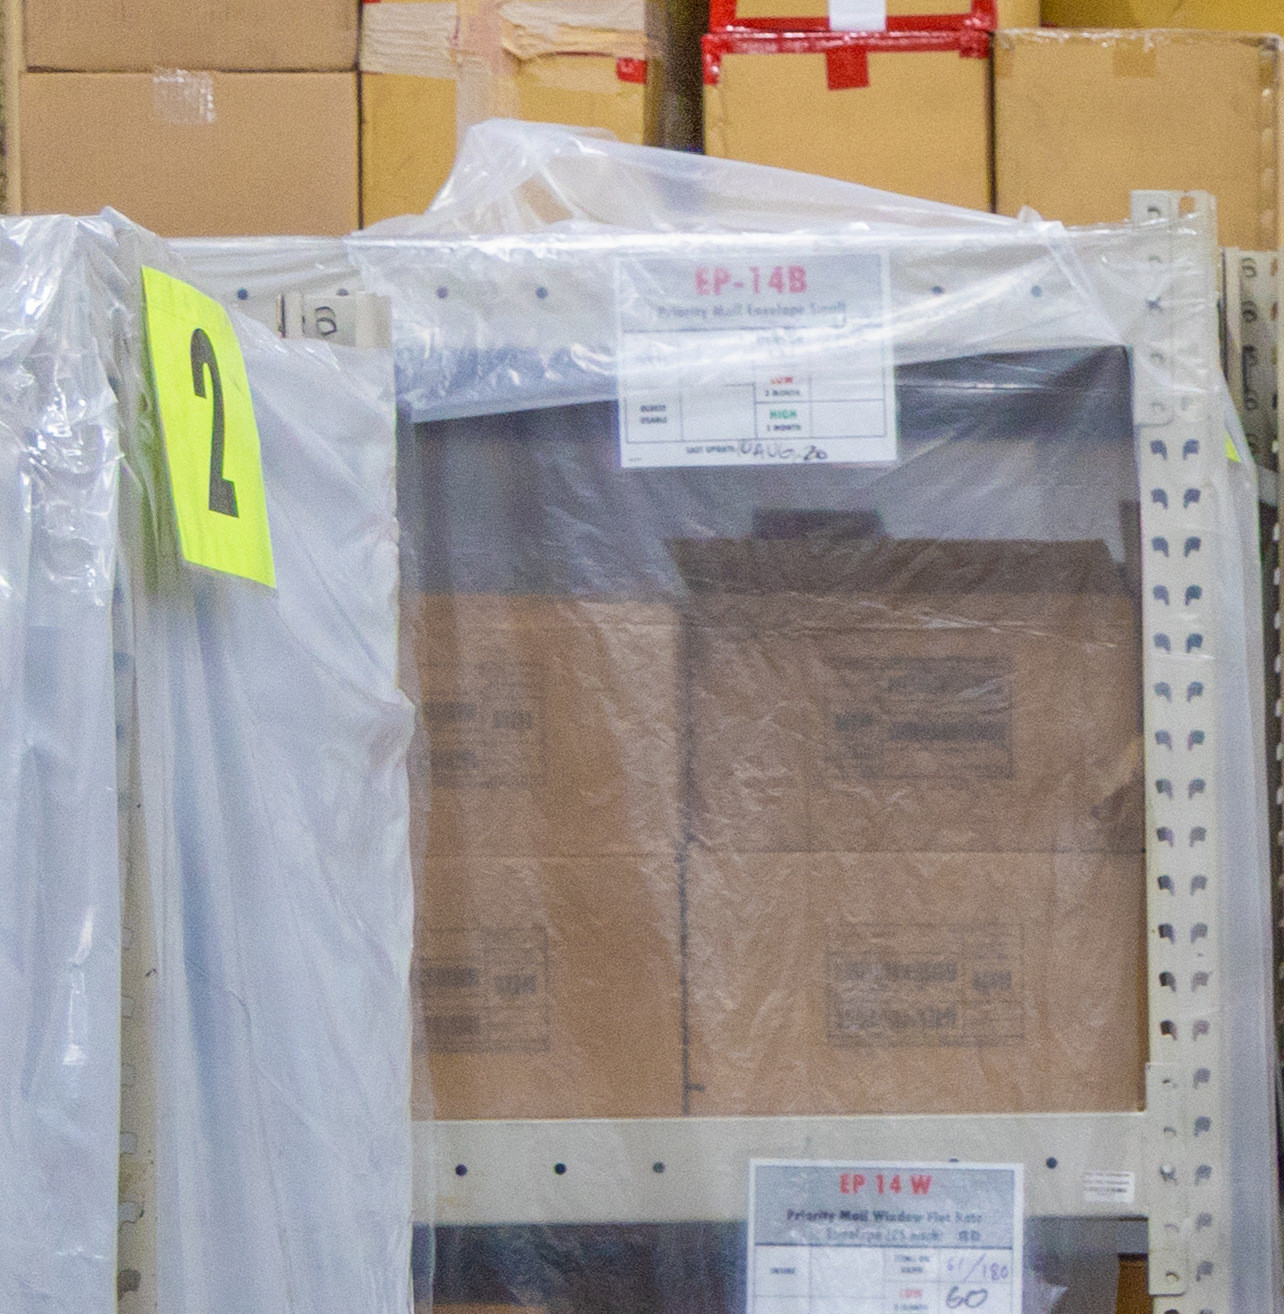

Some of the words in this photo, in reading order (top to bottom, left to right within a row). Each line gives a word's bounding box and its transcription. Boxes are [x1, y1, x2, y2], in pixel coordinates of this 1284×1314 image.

[694, 265, 808, 296] EP-14B
[190, 328, 241, 519] 2
[838, 1172, 867, 1195] EP
[876, 1173, 902, 1195] 14
[909, 1173, 933, 1196] W
